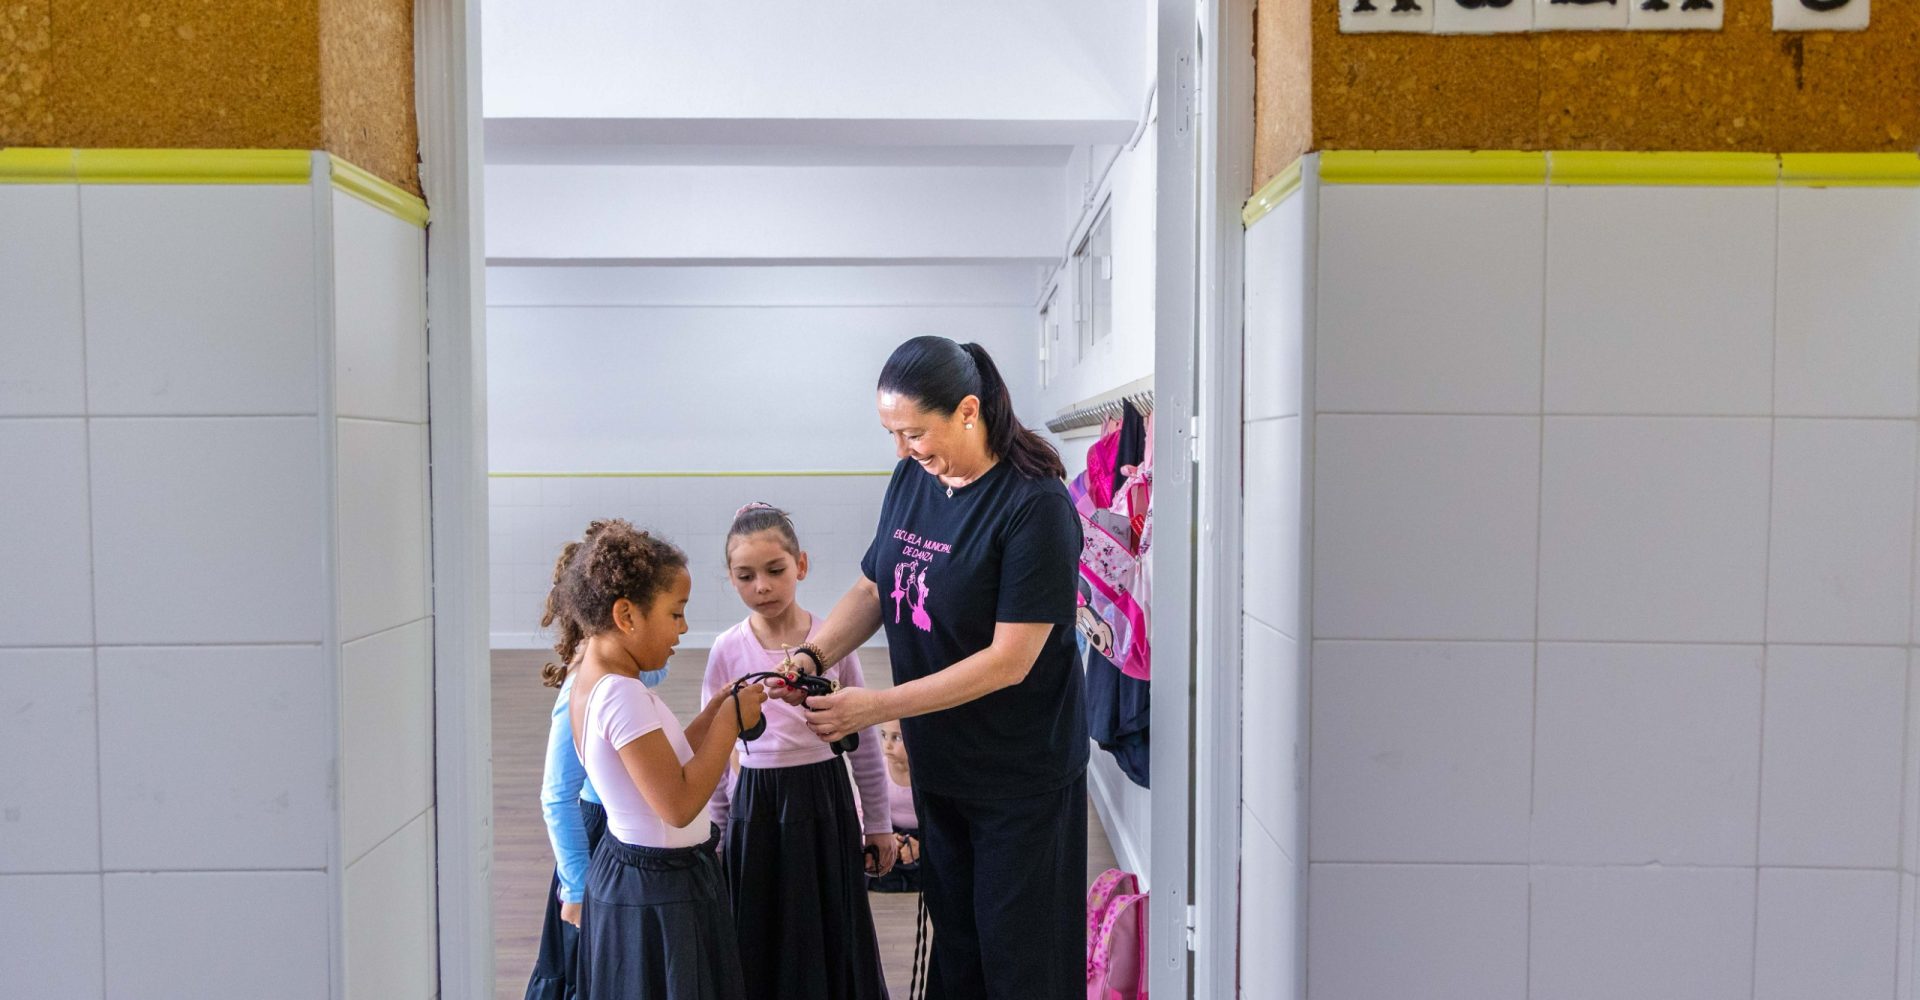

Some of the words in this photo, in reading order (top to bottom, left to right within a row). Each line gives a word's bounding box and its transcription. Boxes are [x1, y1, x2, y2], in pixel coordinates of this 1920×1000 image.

[893, 529, 921, 546] ESCUELA
[923, 540, 952, 553] MUNICIPAL
[902, 546, 913, 556] DE
[911, 549, 933, 562] DANZA
